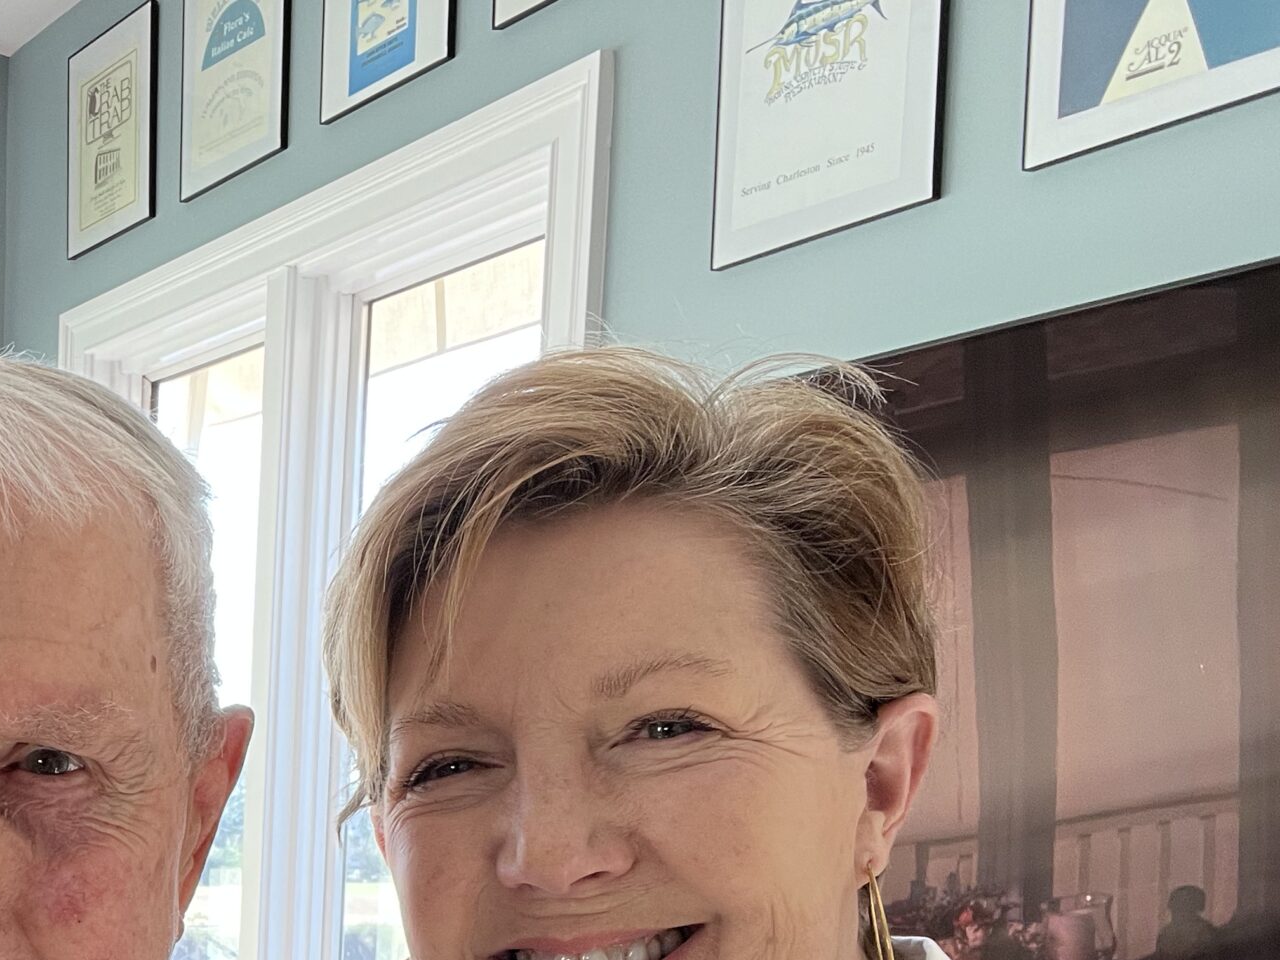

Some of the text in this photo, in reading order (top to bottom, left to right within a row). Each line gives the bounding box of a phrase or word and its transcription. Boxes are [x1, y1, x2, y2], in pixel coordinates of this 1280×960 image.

[211, 39, 235, 57] Italian
[1167, 41, 1182, 67] 2
[89, 98, 131, 139] TRAP
[740, 143, 876, 198] Serving Charleston Since 1945
